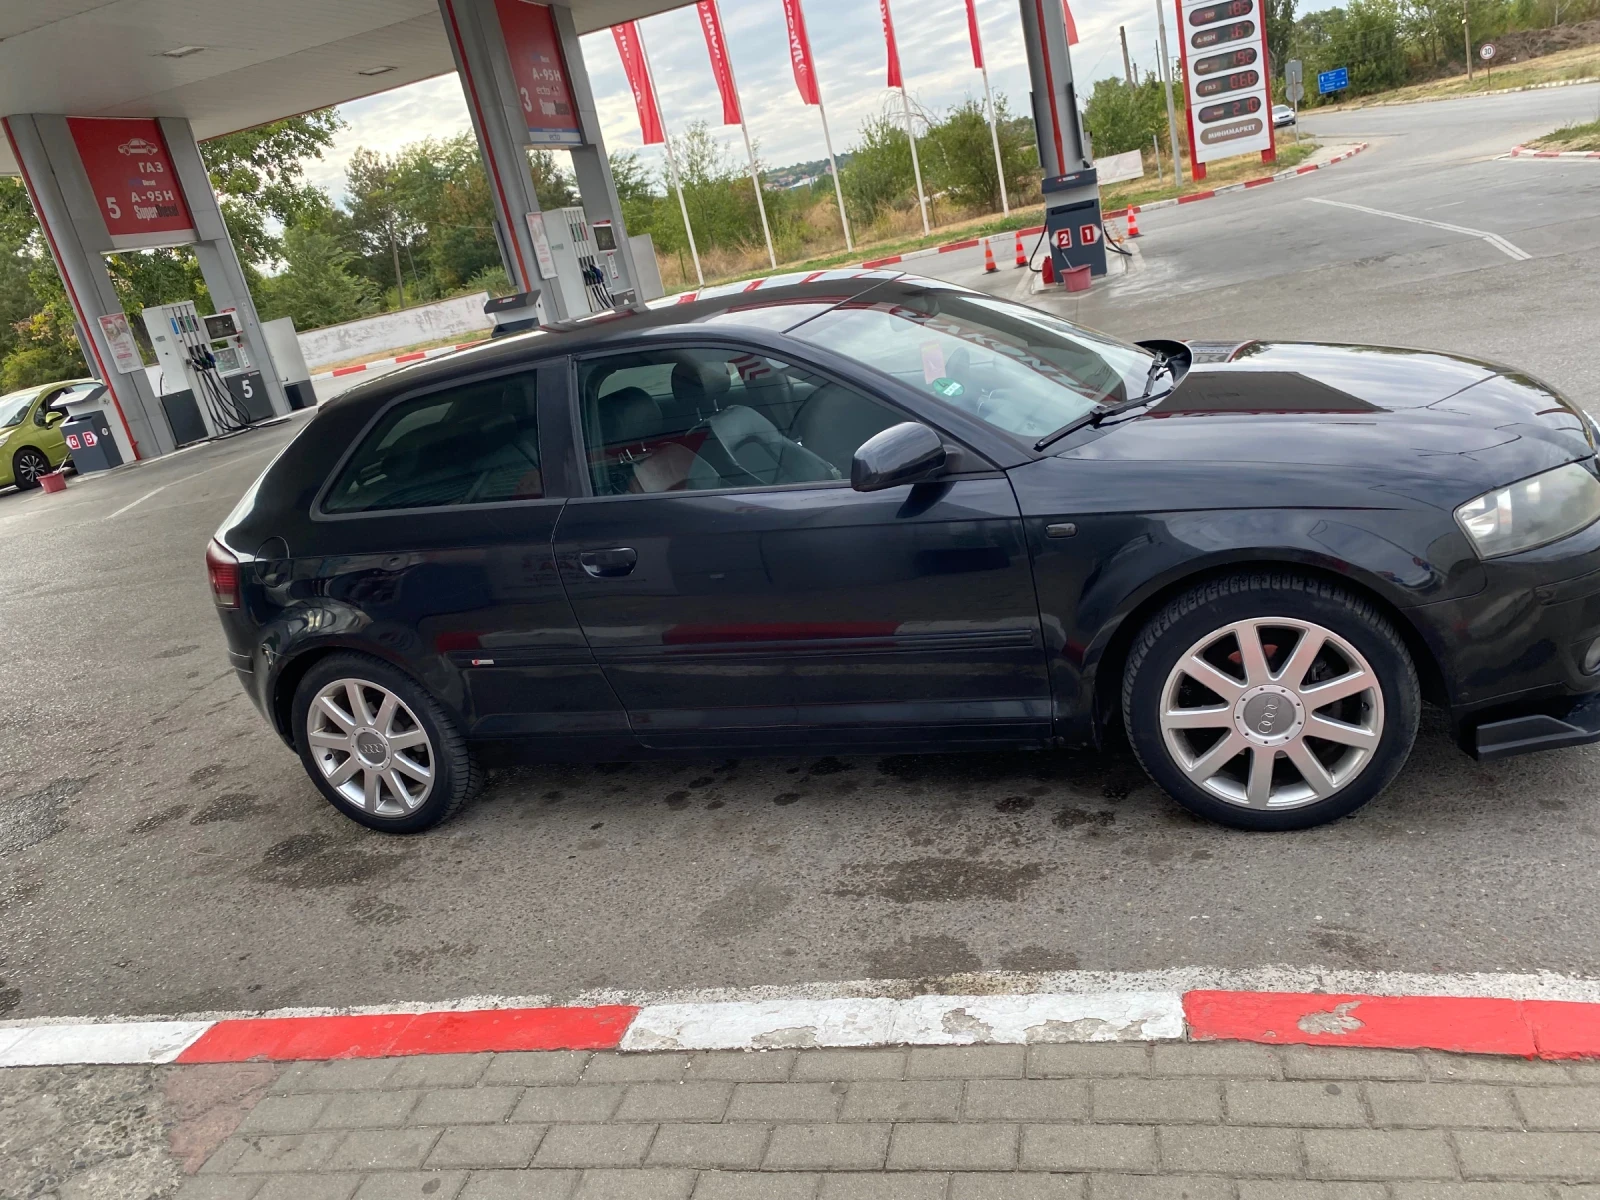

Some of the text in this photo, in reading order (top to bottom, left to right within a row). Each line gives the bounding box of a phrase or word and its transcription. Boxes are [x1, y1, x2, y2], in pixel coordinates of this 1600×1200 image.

[1484, 48, 1492, 56] 30
[520, 87, 533, 112] 3
[1208, 124, 1256, 140] МИНИМАРКЕТ
[138, 162, 164, 173] ГАЗ
[106, 197, 121, 219] 5
[1060, 234, 1068, 245] 2
[1085, 229, 1091, 240] 1
[242, 380, 253, 399] 5
[71, 438, 76, 446] 6
[86, 435, 92, 443] 5
